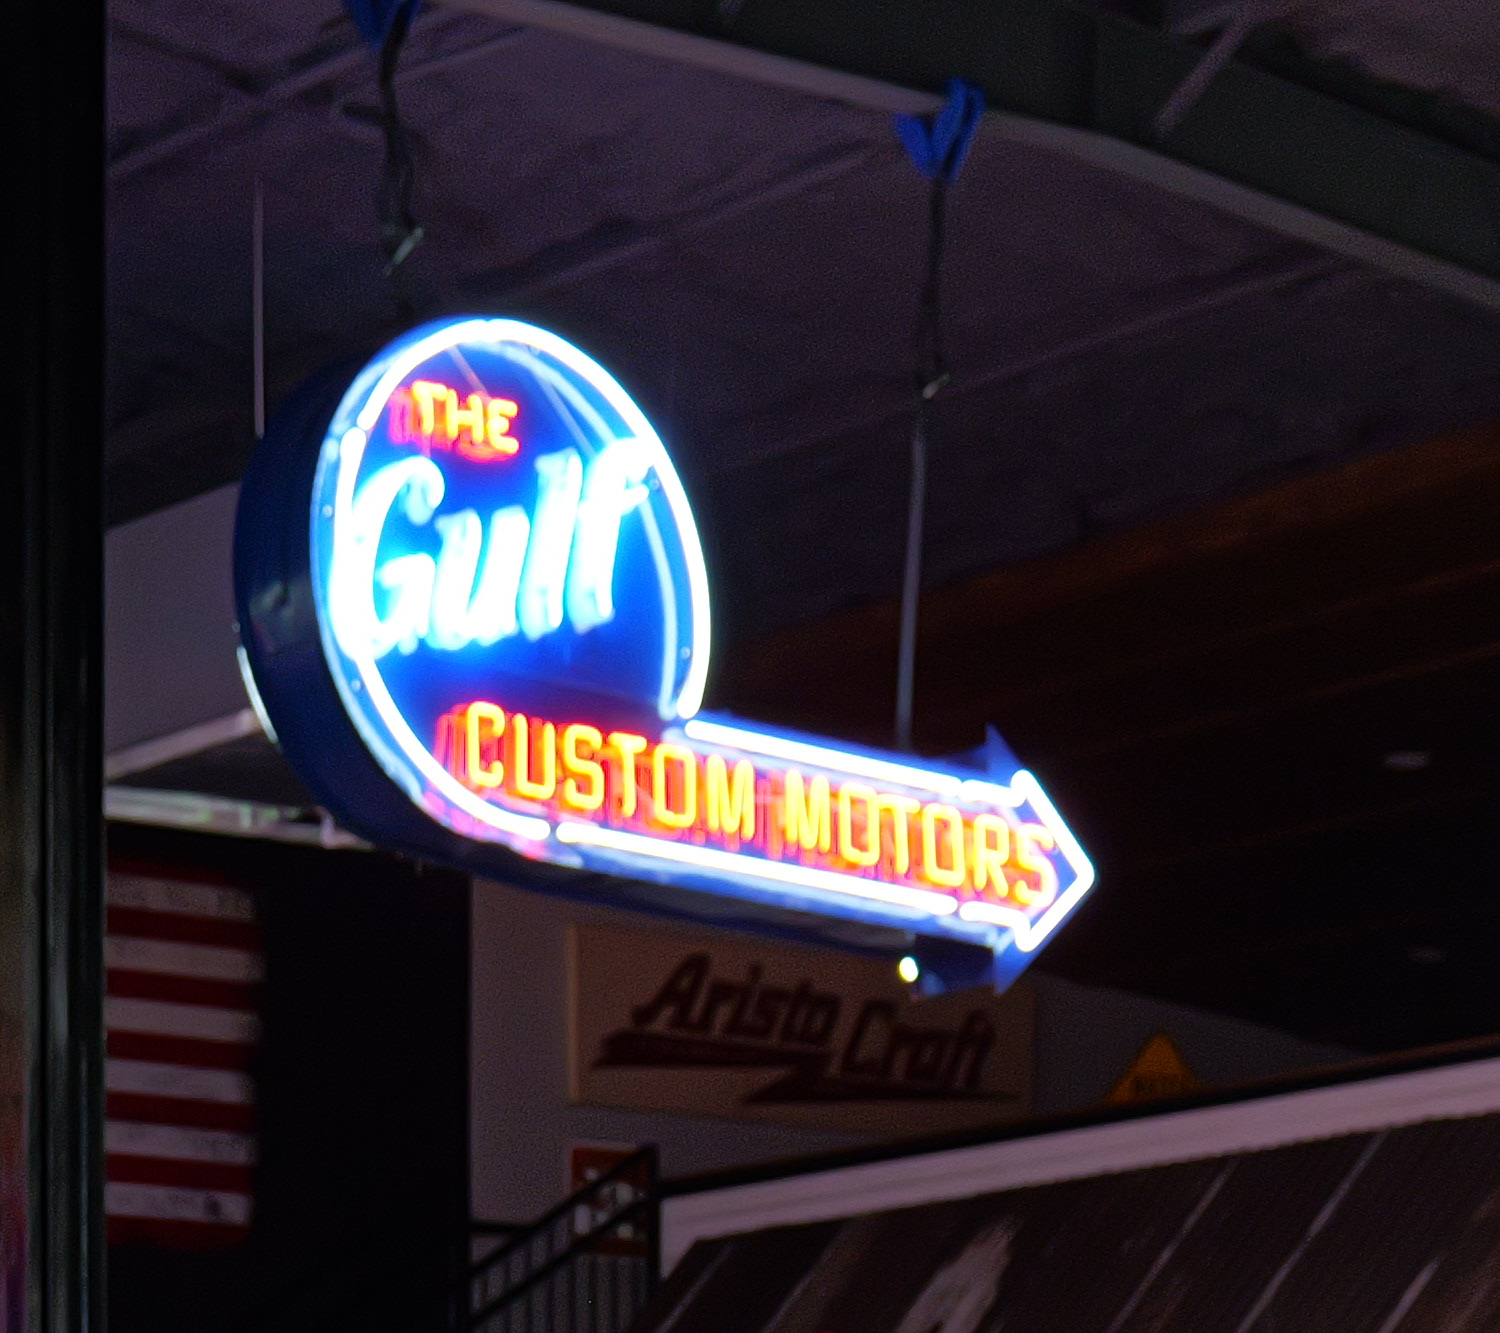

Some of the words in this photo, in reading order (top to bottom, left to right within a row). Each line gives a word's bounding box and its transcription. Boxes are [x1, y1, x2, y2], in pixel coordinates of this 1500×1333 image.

[405, 378, 520, 458] THE
[332, 436, 656, 662] Gulf
[452, 700, 757, 843] CUSTOM
[782, 768, 1060, 909] MOTORS
